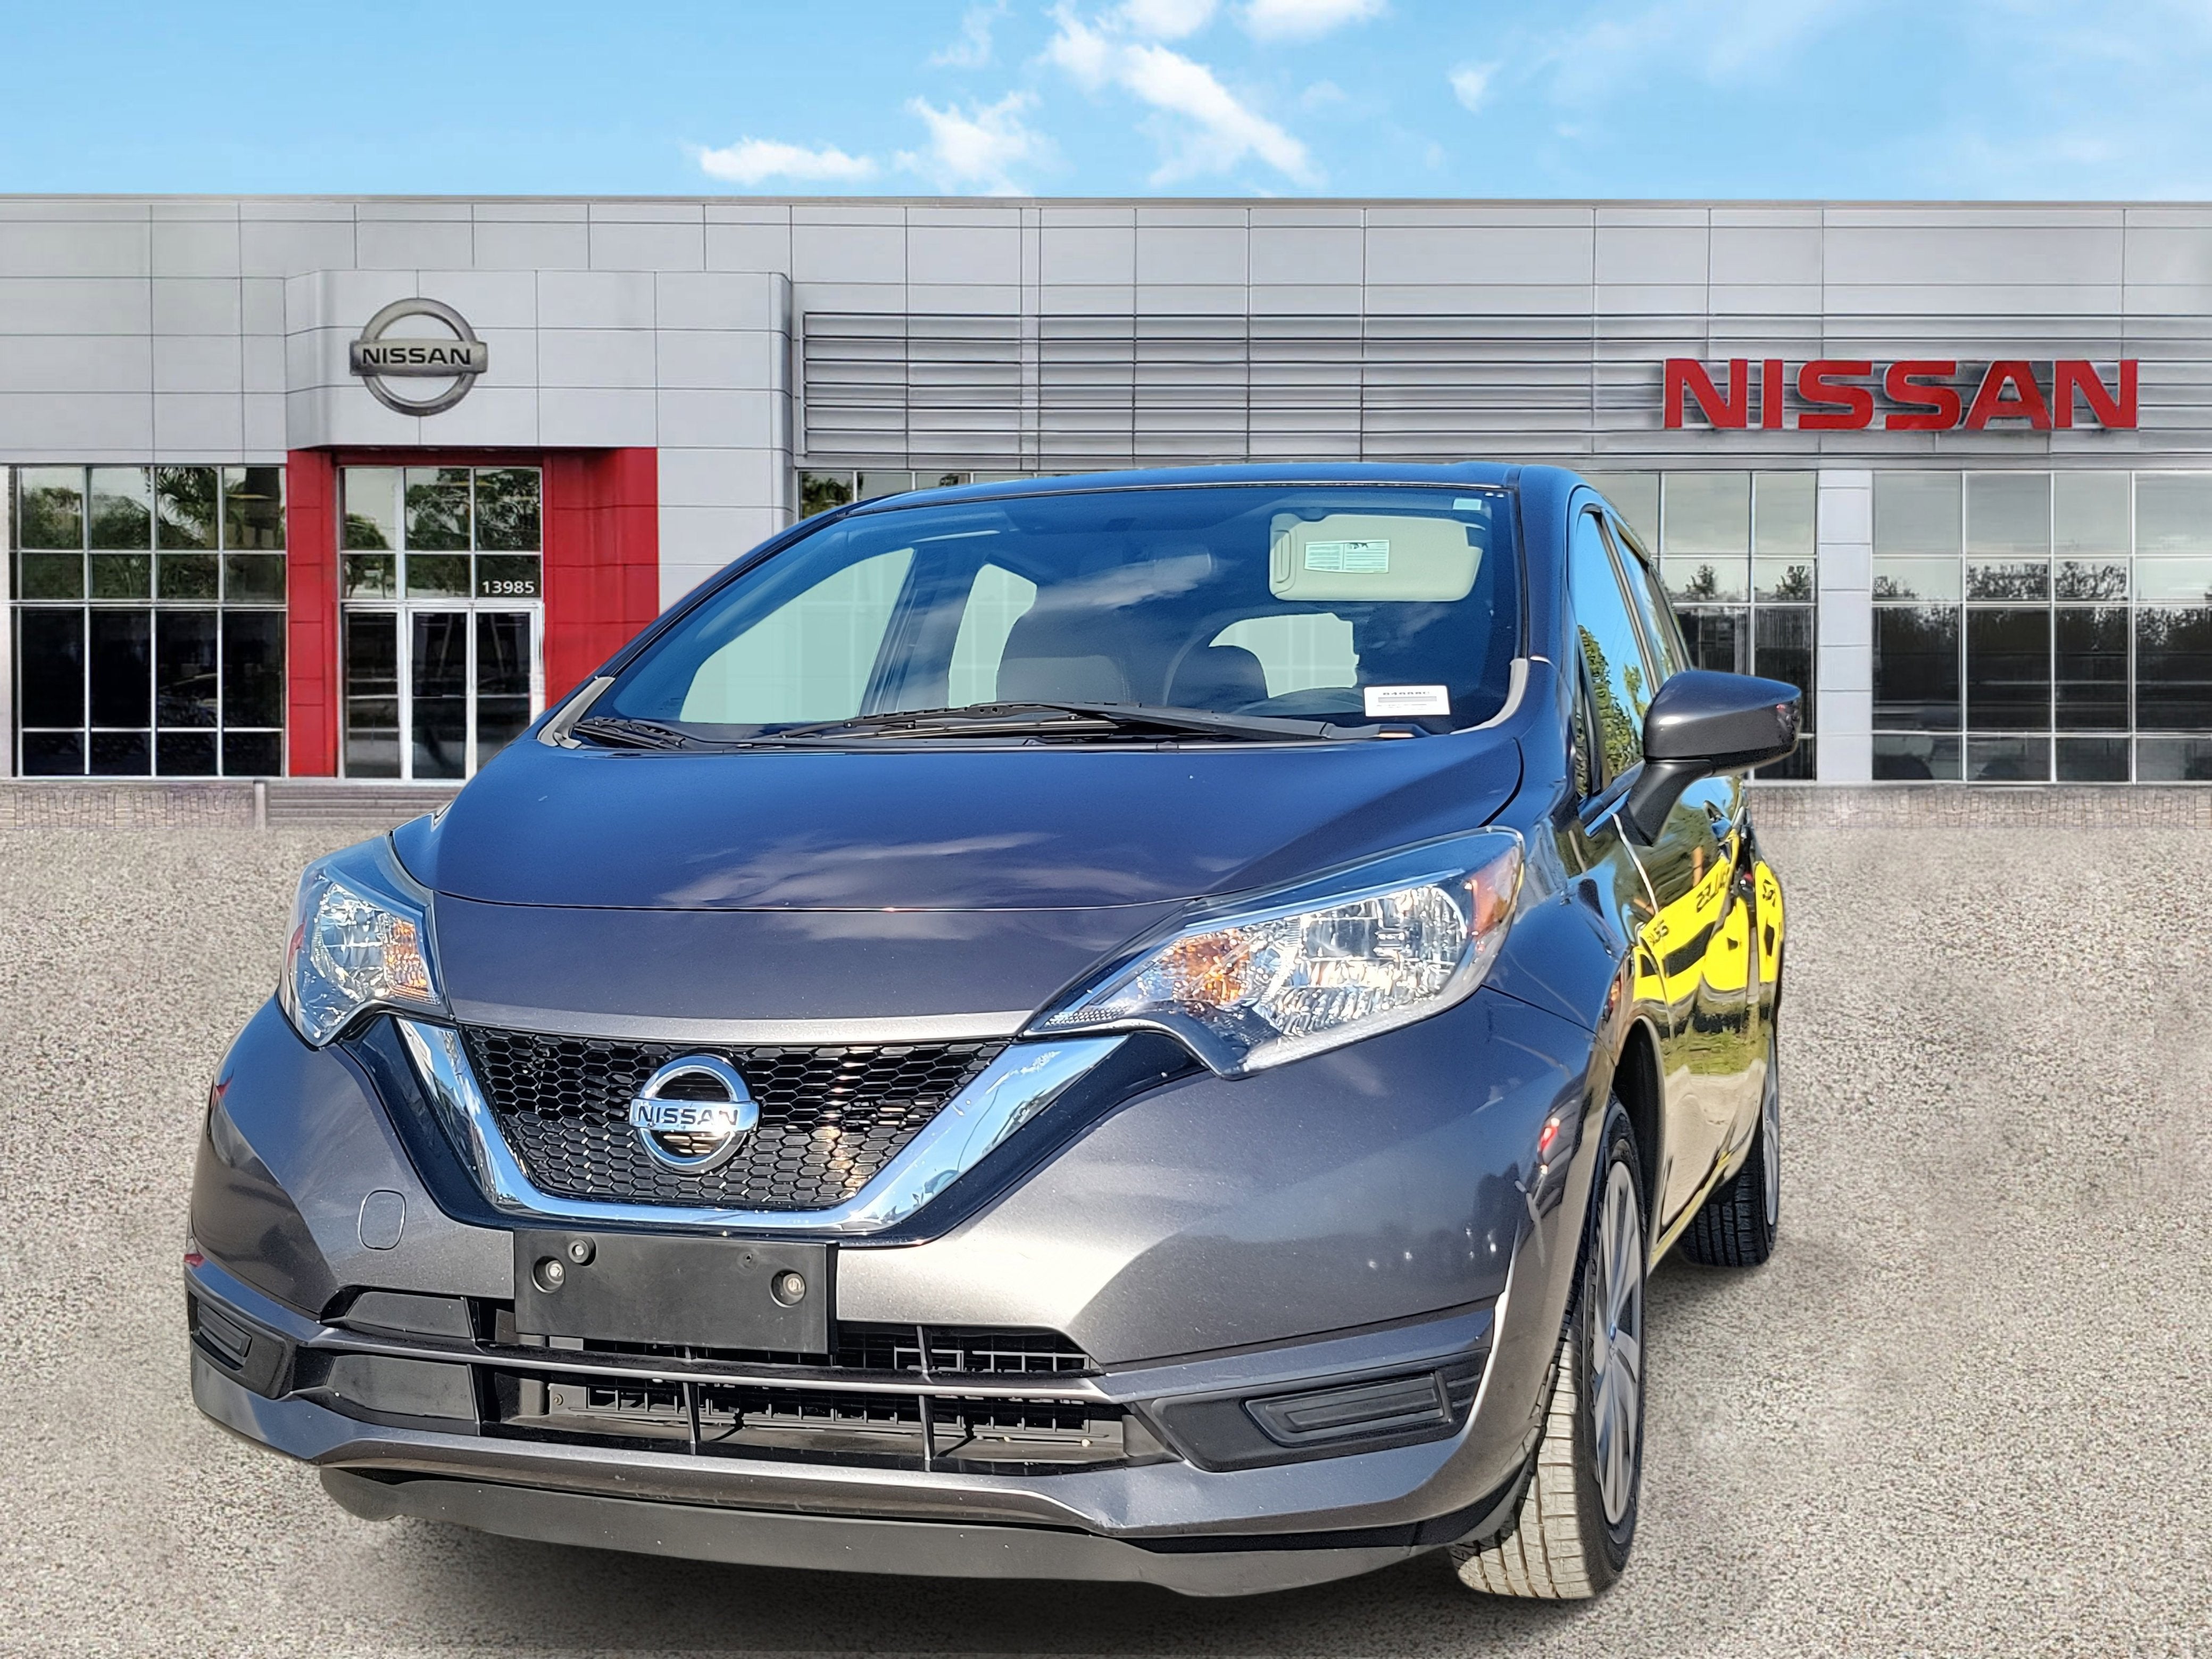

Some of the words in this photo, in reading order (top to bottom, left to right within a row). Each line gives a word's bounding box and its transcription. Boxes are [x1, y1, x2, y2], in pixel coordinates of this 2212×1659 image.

[362, 348, 471, 364] NISSAN
[1663, 358, 2139, 430] NISSAN
[482, 580, 535, 594] 13985
[638, 1106, 738, 1126] NISSAN
